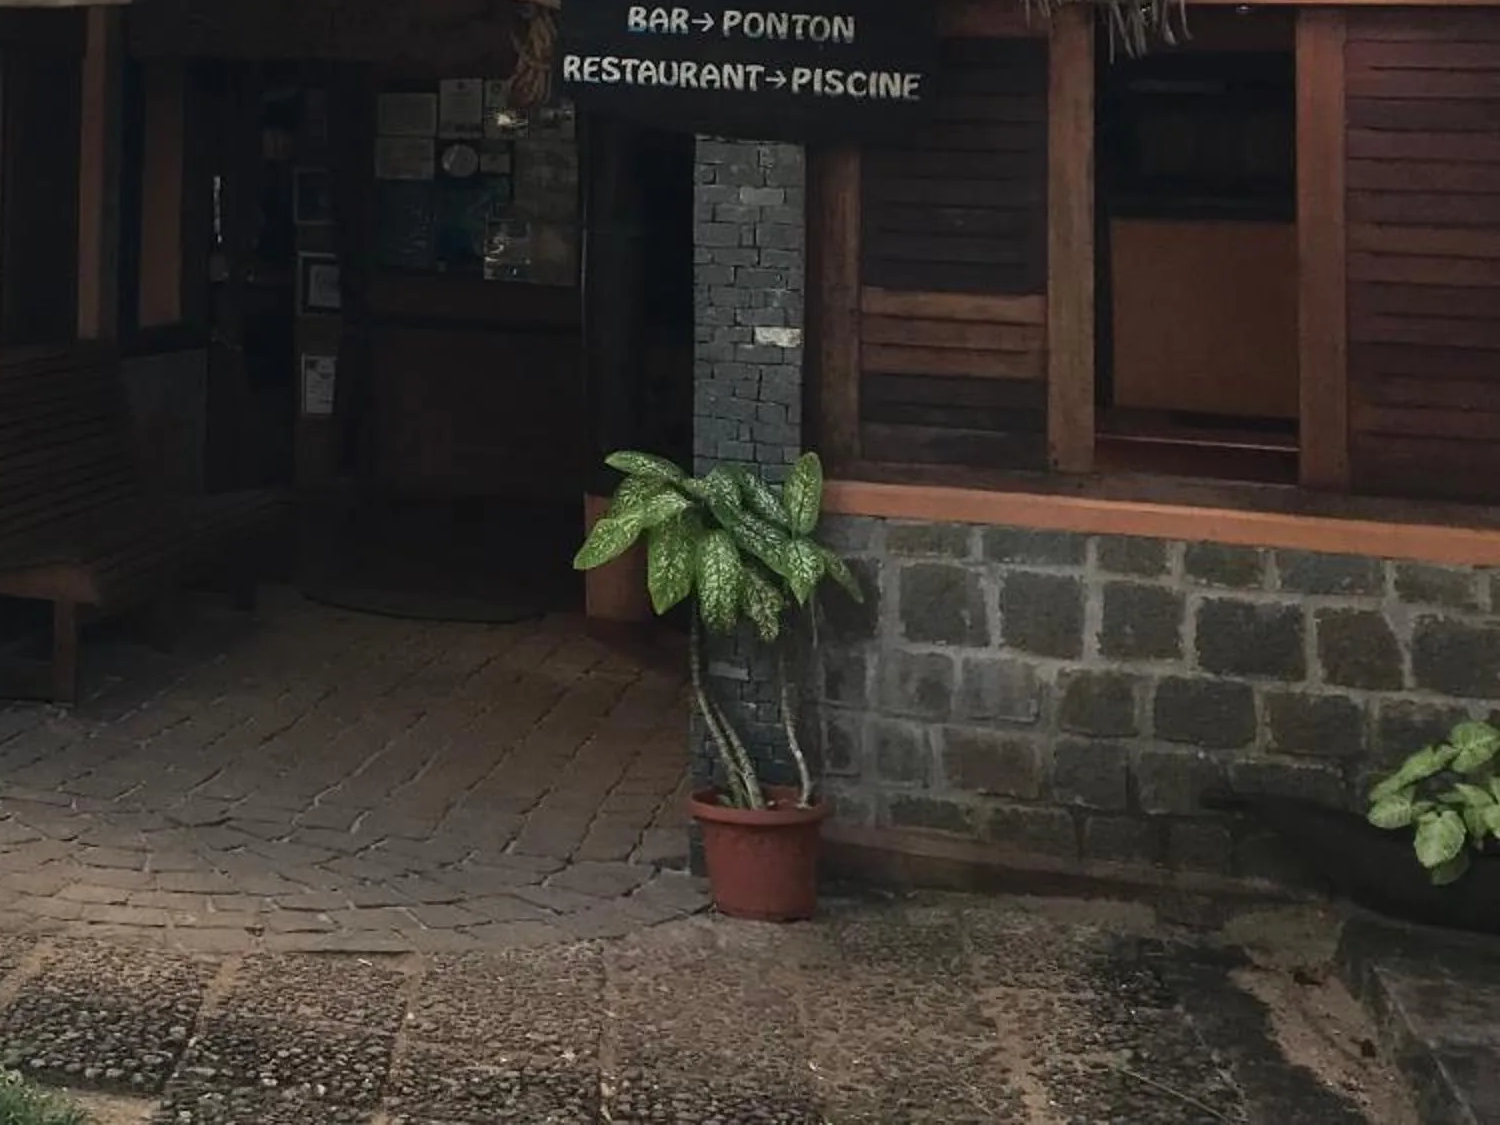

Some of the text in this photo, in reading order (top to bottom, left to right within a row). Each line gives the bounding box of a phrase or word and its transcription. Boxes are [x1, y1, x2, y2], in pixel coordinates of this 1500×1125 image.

[626, 5, 856, 44] BAR PONTON
[562, 54, 922, 101] RESTAURANT PISCINE
